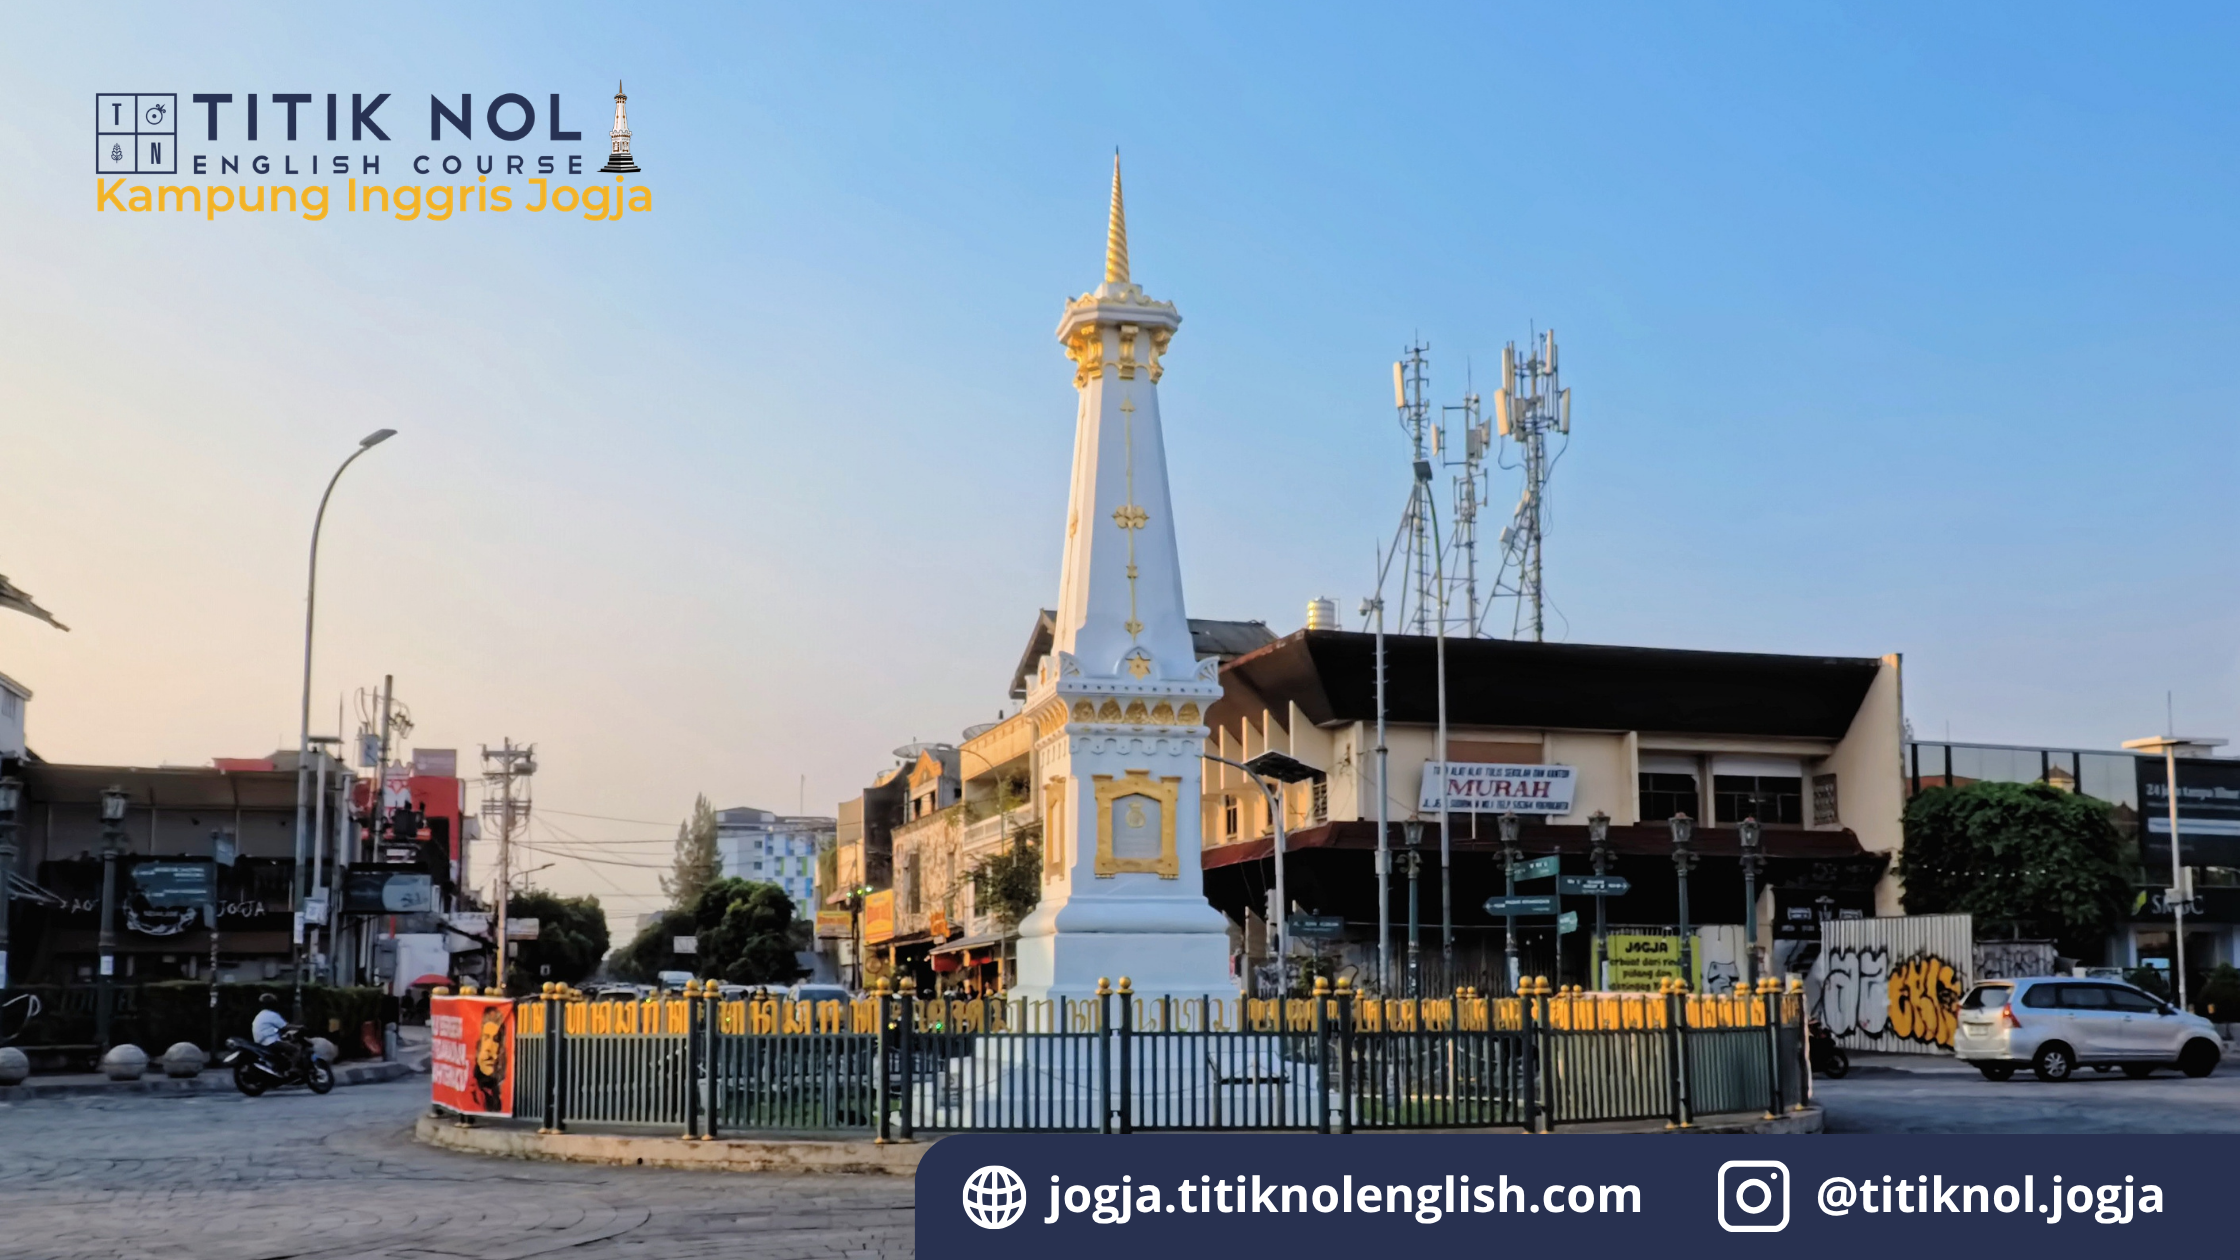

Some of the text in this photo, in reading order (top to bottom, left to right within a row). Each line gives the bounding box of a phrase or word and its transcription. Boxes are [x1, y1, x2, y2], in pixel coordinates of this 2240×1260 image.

[1447, 778, 1551, 798] MURAH
[2145, 783, 2160, 796] 24
[1625, 941, 1668, 953] JOGJA
